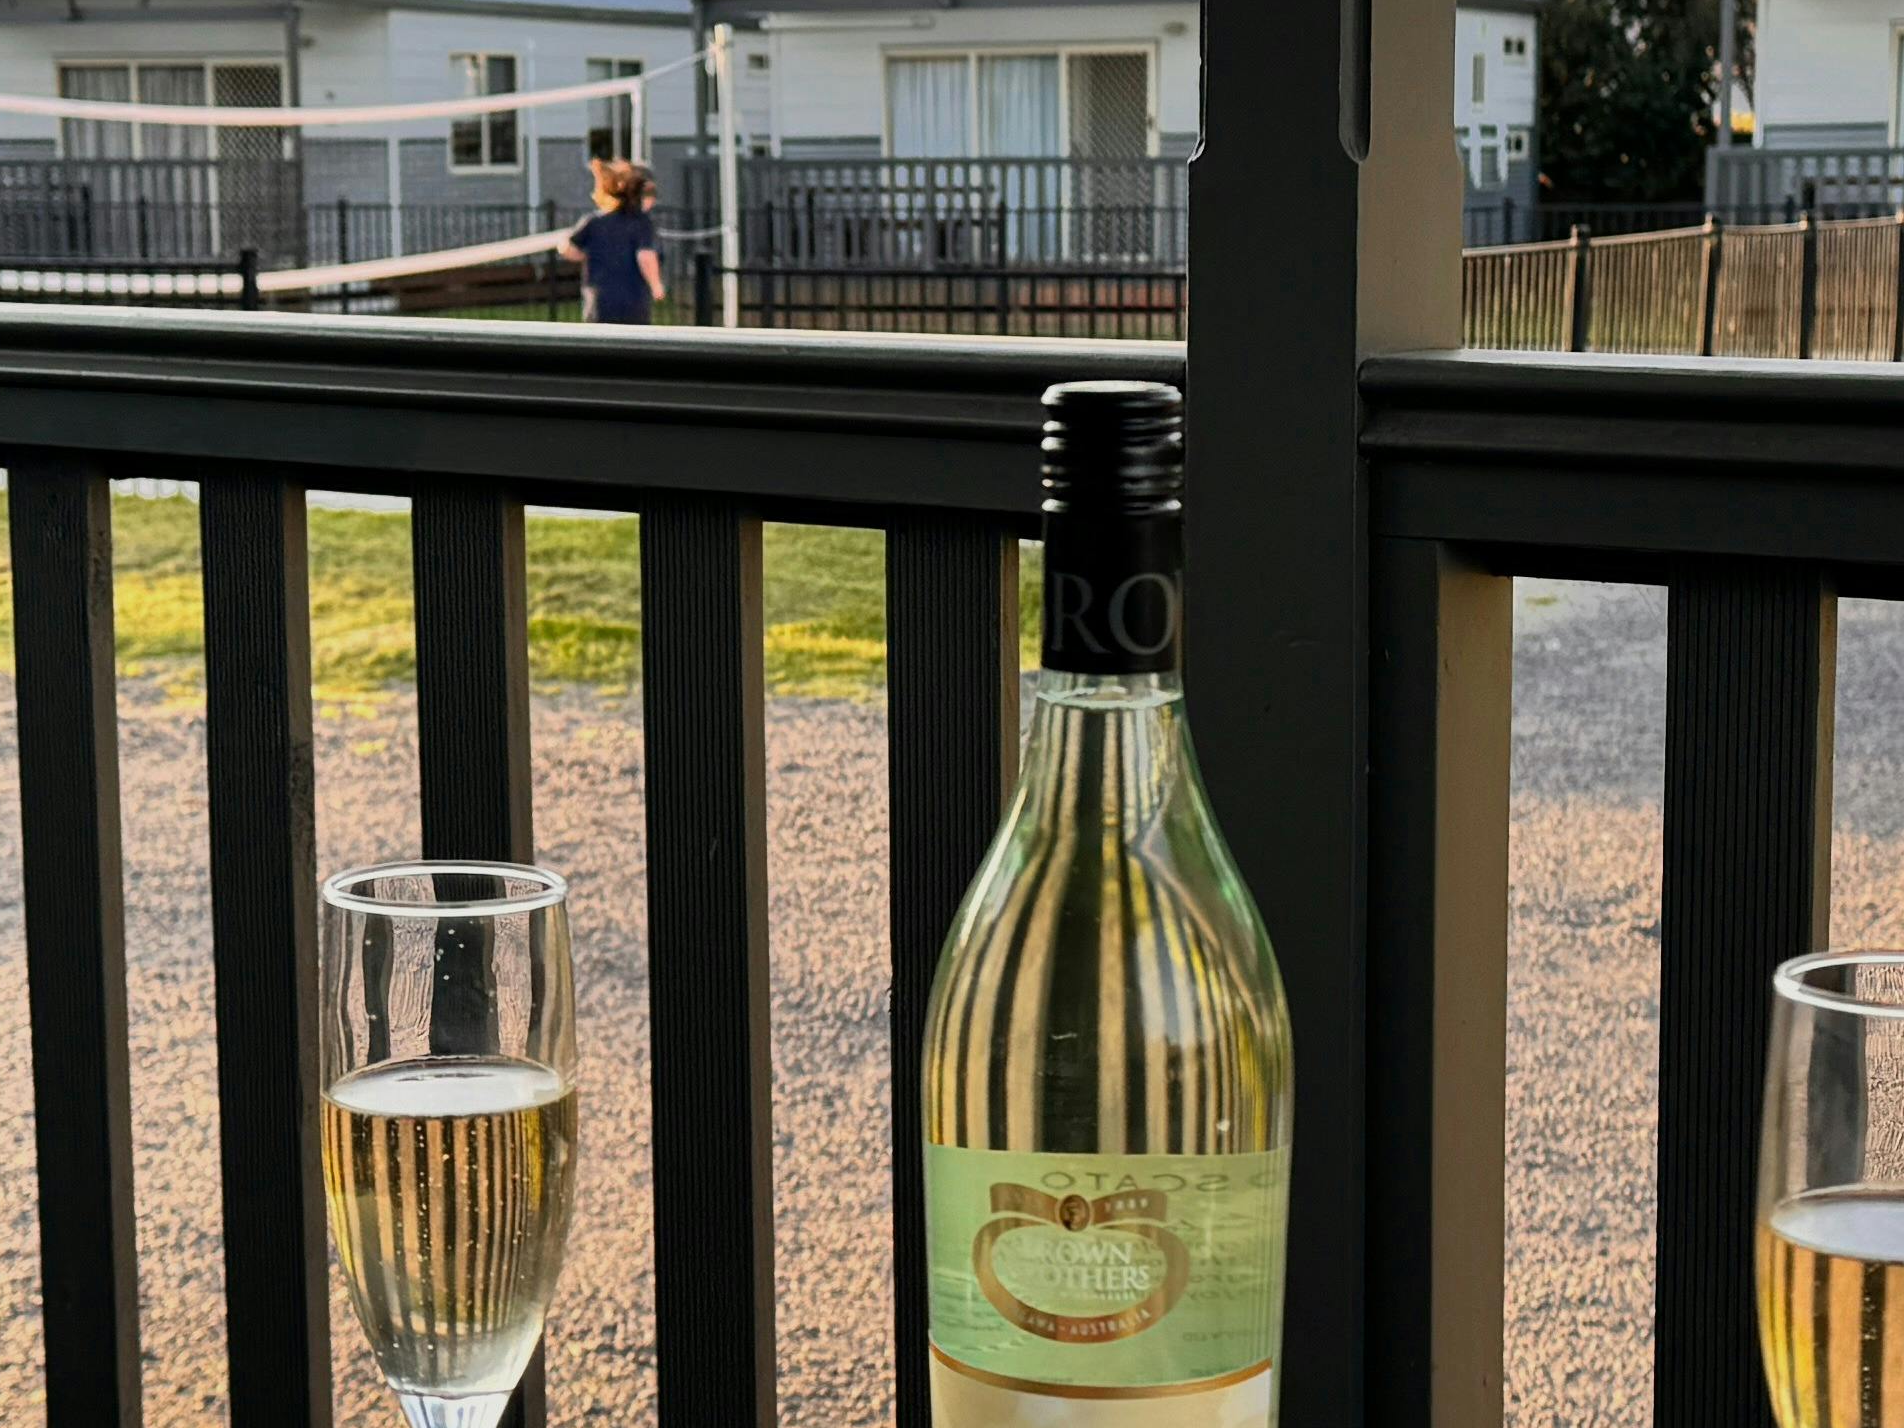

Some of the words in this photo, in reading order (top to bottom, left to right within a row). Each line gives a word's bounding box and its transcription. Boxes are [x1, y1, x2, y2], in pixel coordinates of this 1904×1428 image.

[1050, 571, 1181, 655] RO
[1040, 1239, 1133, 1265] ROWN
[1042, 1265, 1152, 1291] OTHERS
